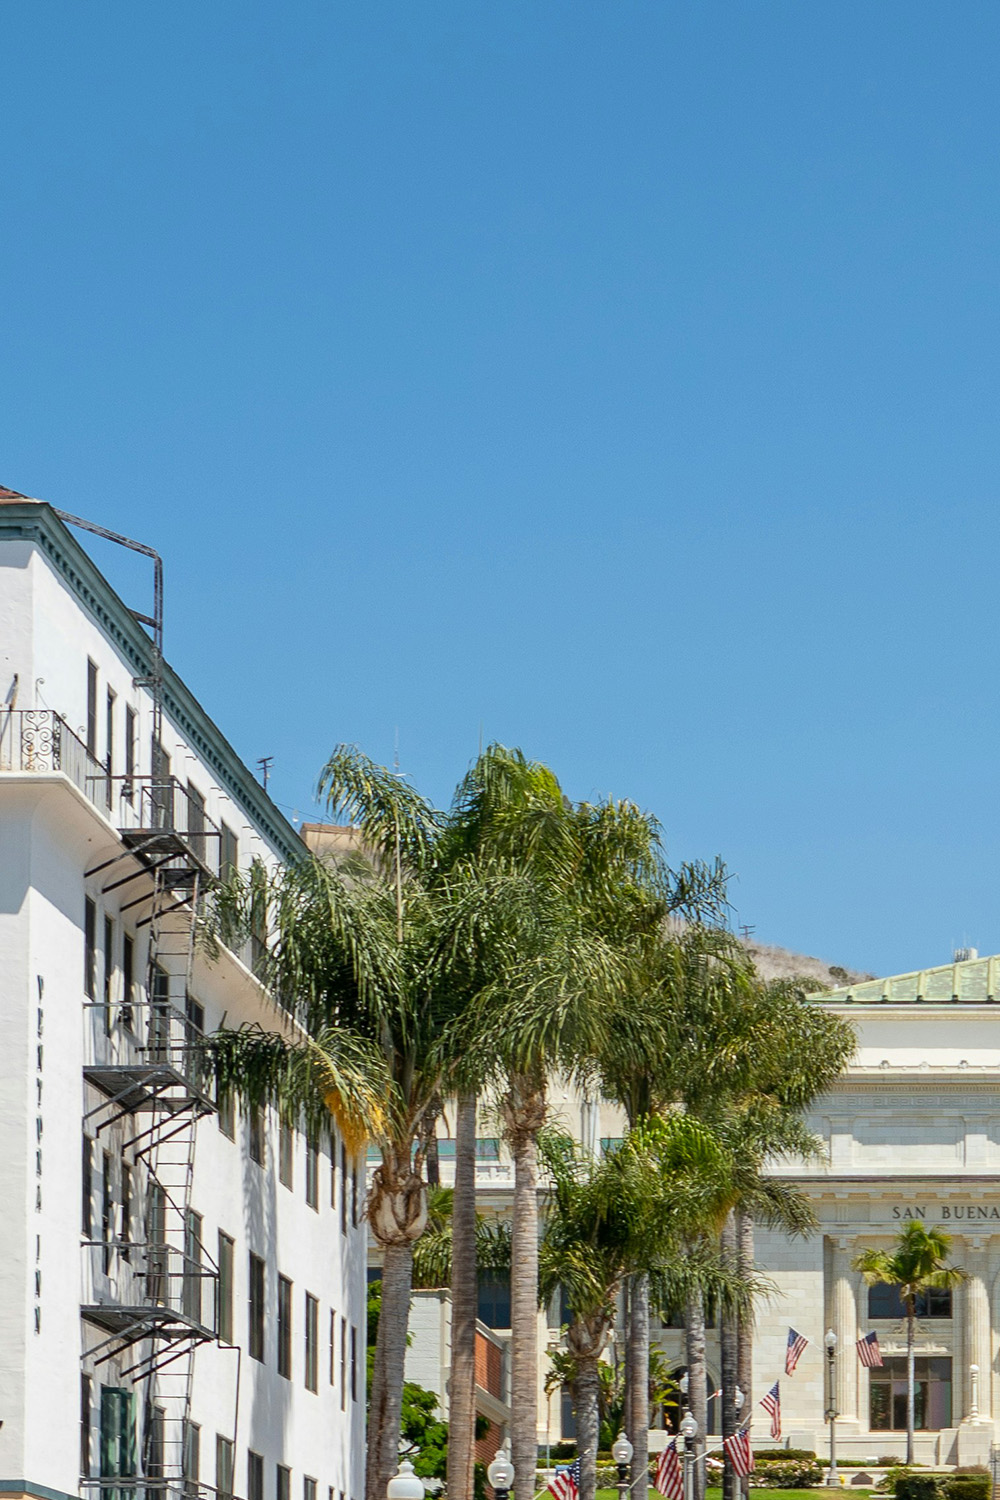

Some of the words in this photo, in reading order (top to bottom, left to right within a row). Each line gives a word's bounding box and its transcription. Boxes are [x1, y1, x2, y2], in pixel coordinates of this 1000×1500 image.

[34, 974, 45, 1214] VENTURA
[892, 1206, 926, 1220] SAN
[34, 1233, 42, 1336] INN
